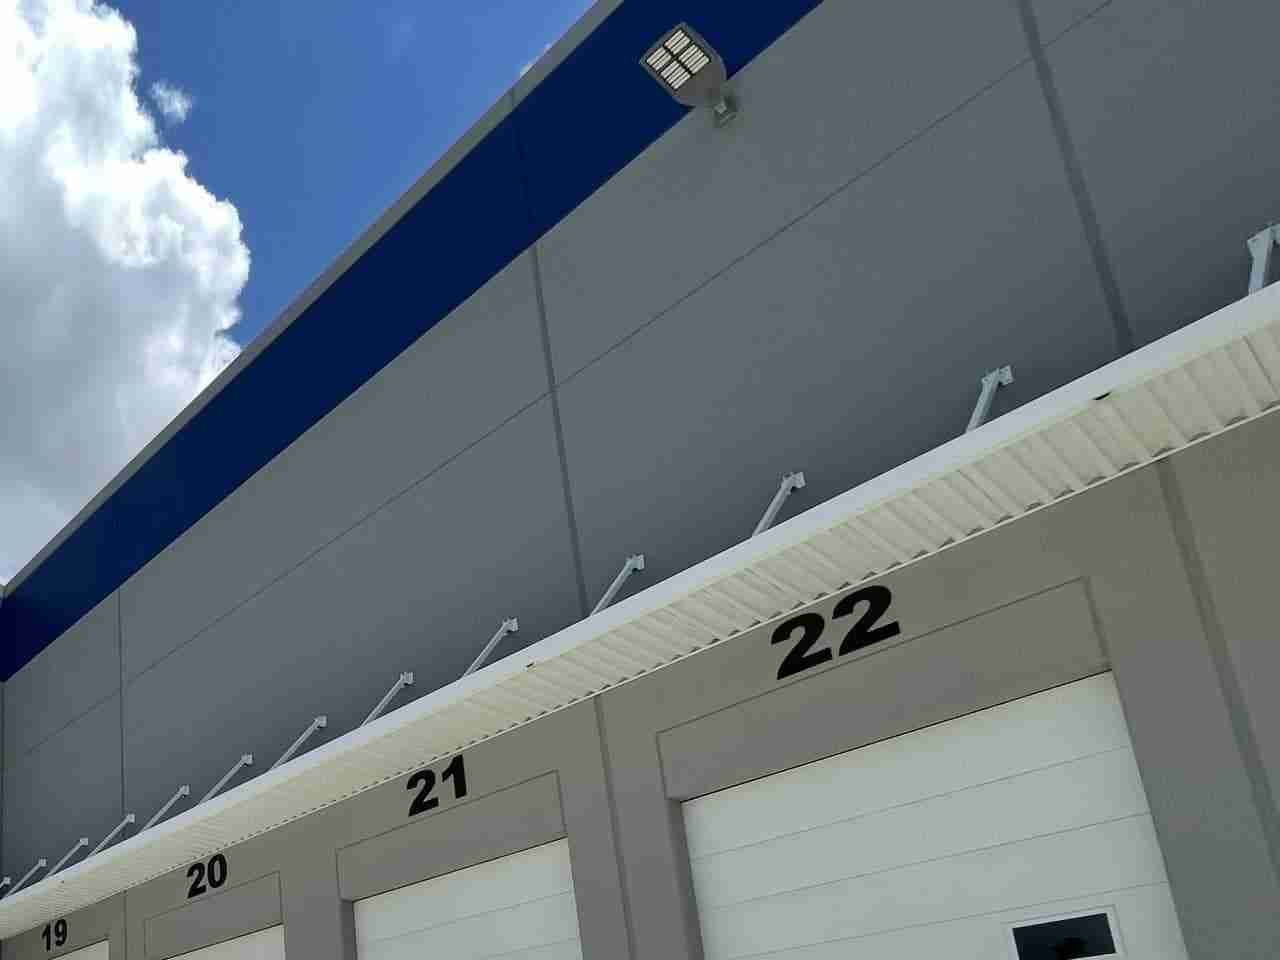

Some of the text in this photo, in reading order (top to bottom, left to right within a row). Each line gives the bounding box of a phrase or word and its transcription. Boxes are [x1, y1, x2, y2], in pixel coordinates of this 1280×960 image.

[770, 585, 901, 680] 22
[406, 754, 468, 817] 21
[186, 853, 228, 899] 20
[40, 918, 68, 953] 19
